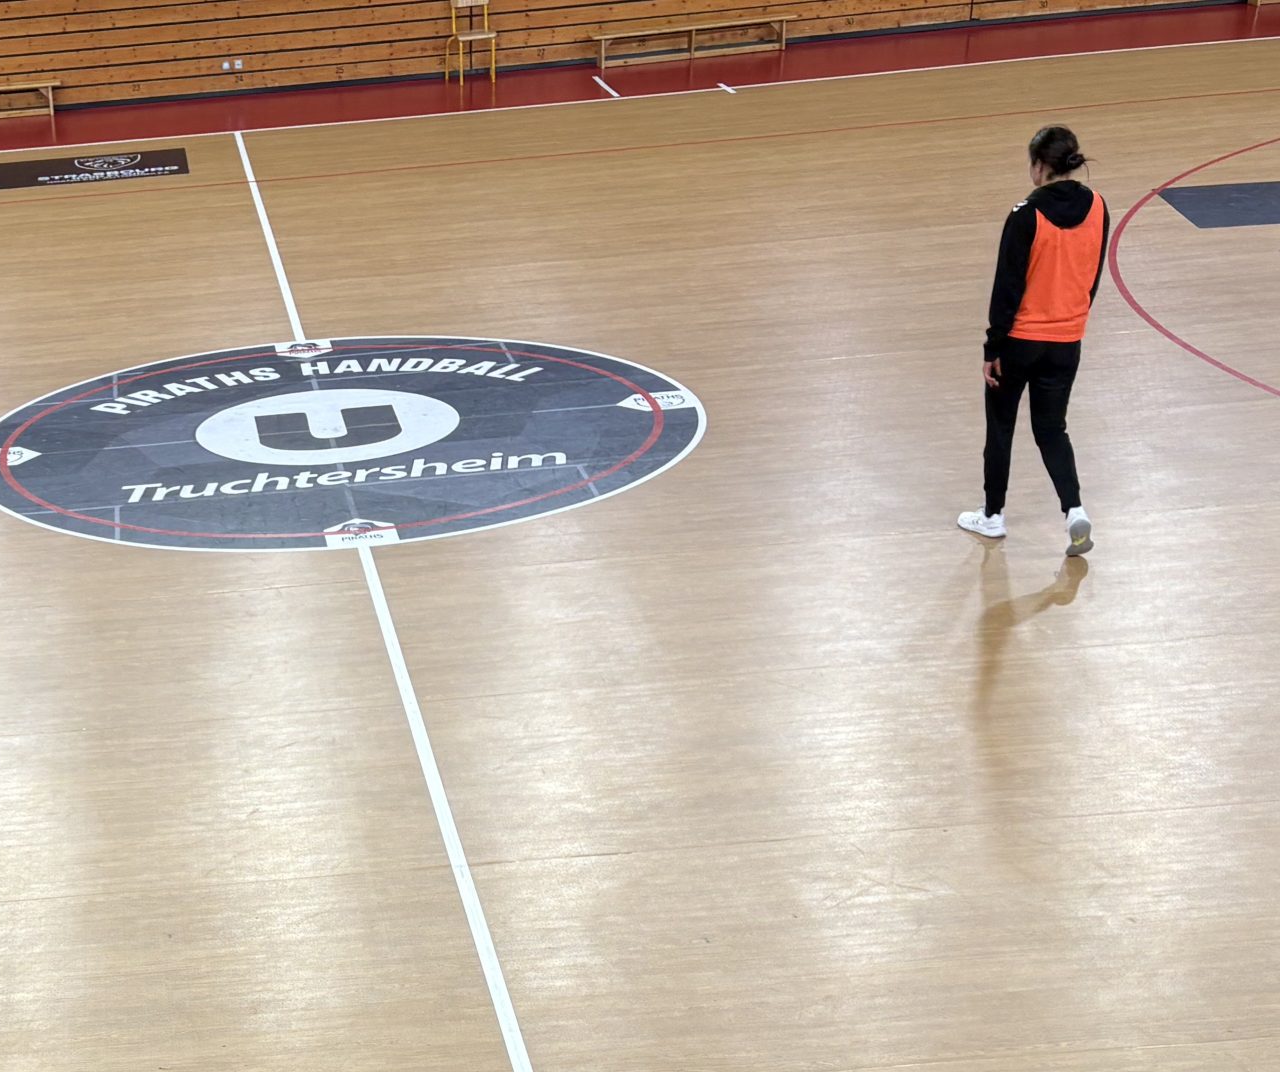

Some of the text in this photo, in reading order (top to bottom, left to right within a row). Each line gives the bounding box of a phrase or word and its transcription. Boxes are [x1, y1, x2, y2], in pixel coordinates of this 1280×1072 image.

[90, 357, 544, 415] PIRATHS HANDBALL
[633, 393, 684, 403] PIATHS
[254, 404, 403, 452] U
[121, 449, 567, 503] Truchtersheim
